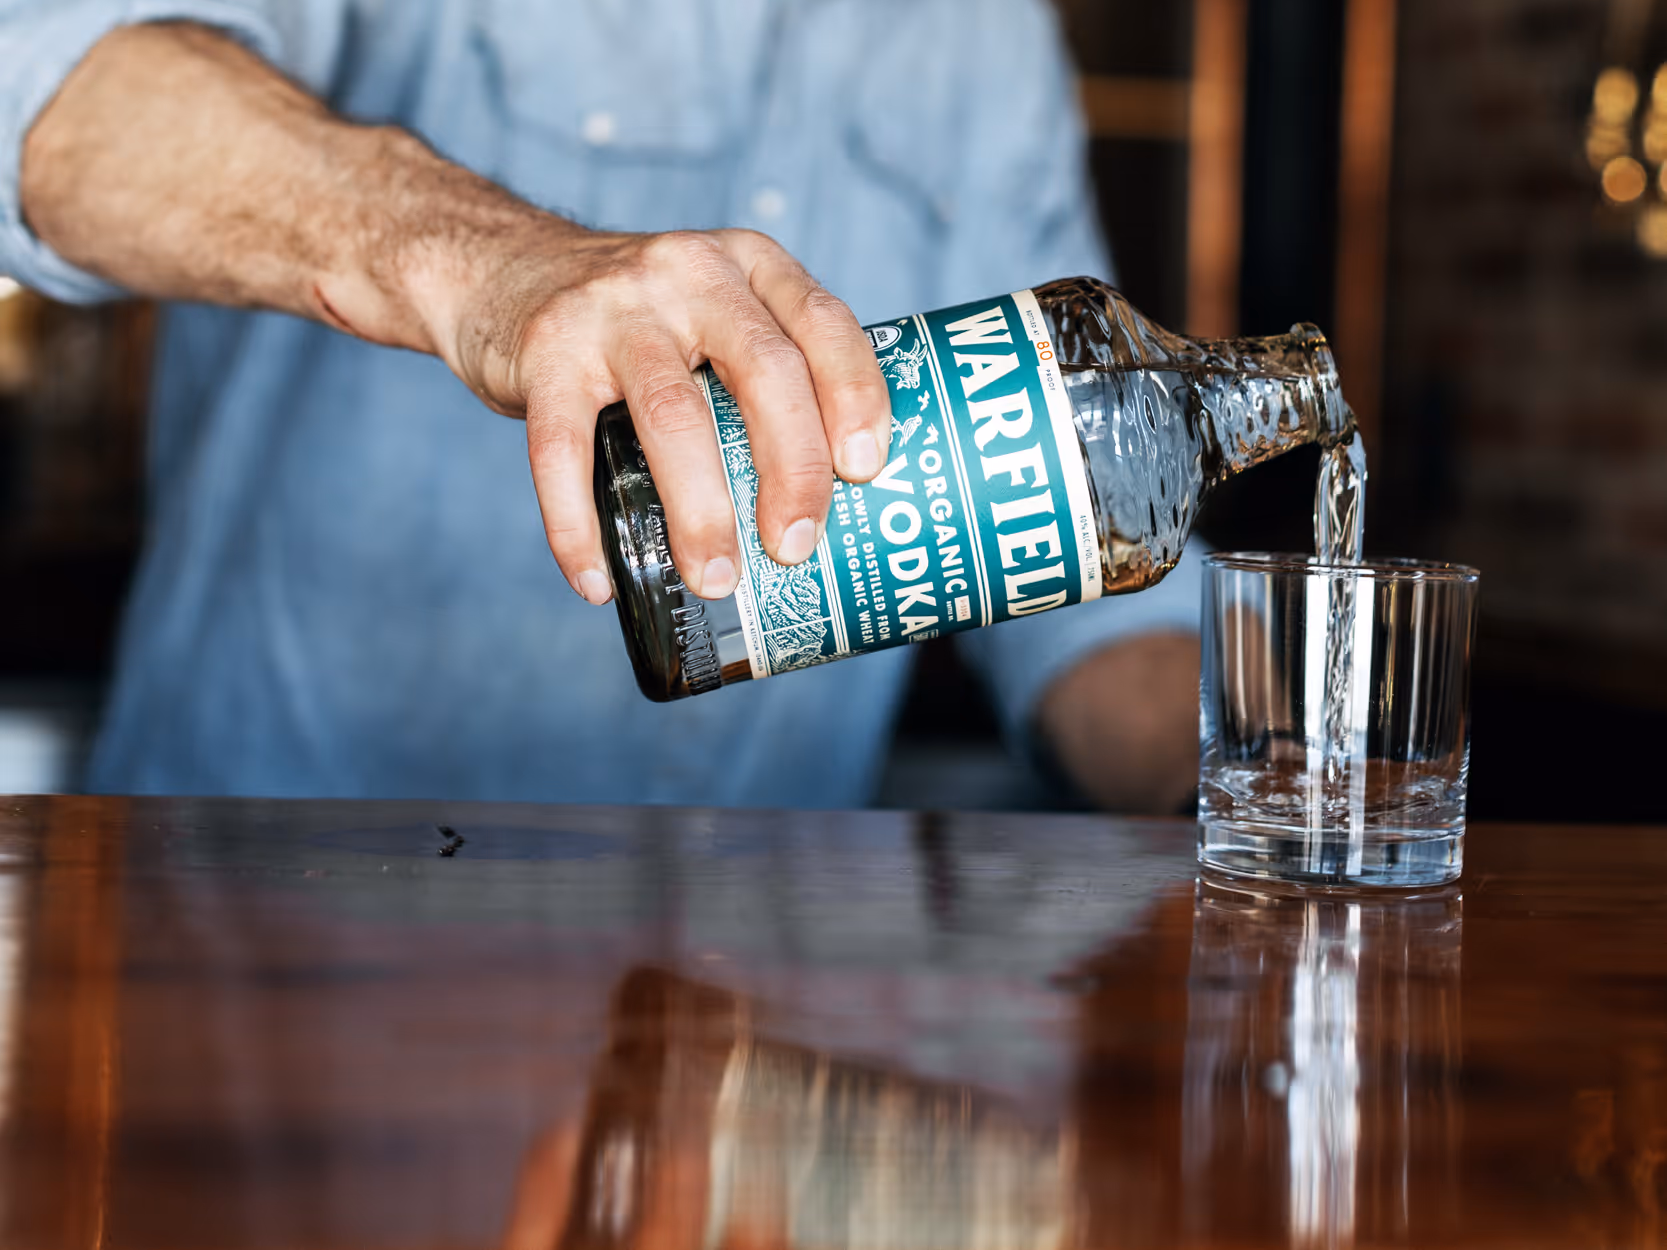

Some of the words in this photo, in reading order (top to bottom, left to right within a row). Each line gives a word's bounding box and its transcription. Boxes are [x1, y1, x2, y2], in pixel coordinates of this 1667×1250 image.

[875, 330, 889, 343] USDA
[1025, 309, 1037, 329] BOTTLED
[1036, 340, 1053, 361] 80
[1045, 368, 1056, 391] PROOF
[918, 449, 968, 594] ORGANIC
[944, 305, 1067, 617] WARFIELD
[1079, 514, 1088, 530] 40%
[740, 582, 753, 617] DISTILLERY
[832, 473, 851, 526] RESH
[842, 533, 868, 607] ORGANIC
[858, 609, 874, 644] WHEAT
[849, 482, 871, 535] OWLY
[862, 541, 886, 612] DISTILLED
[876, 614, 891, 641] FROM
[871, 453, 939, 637] VODKA
